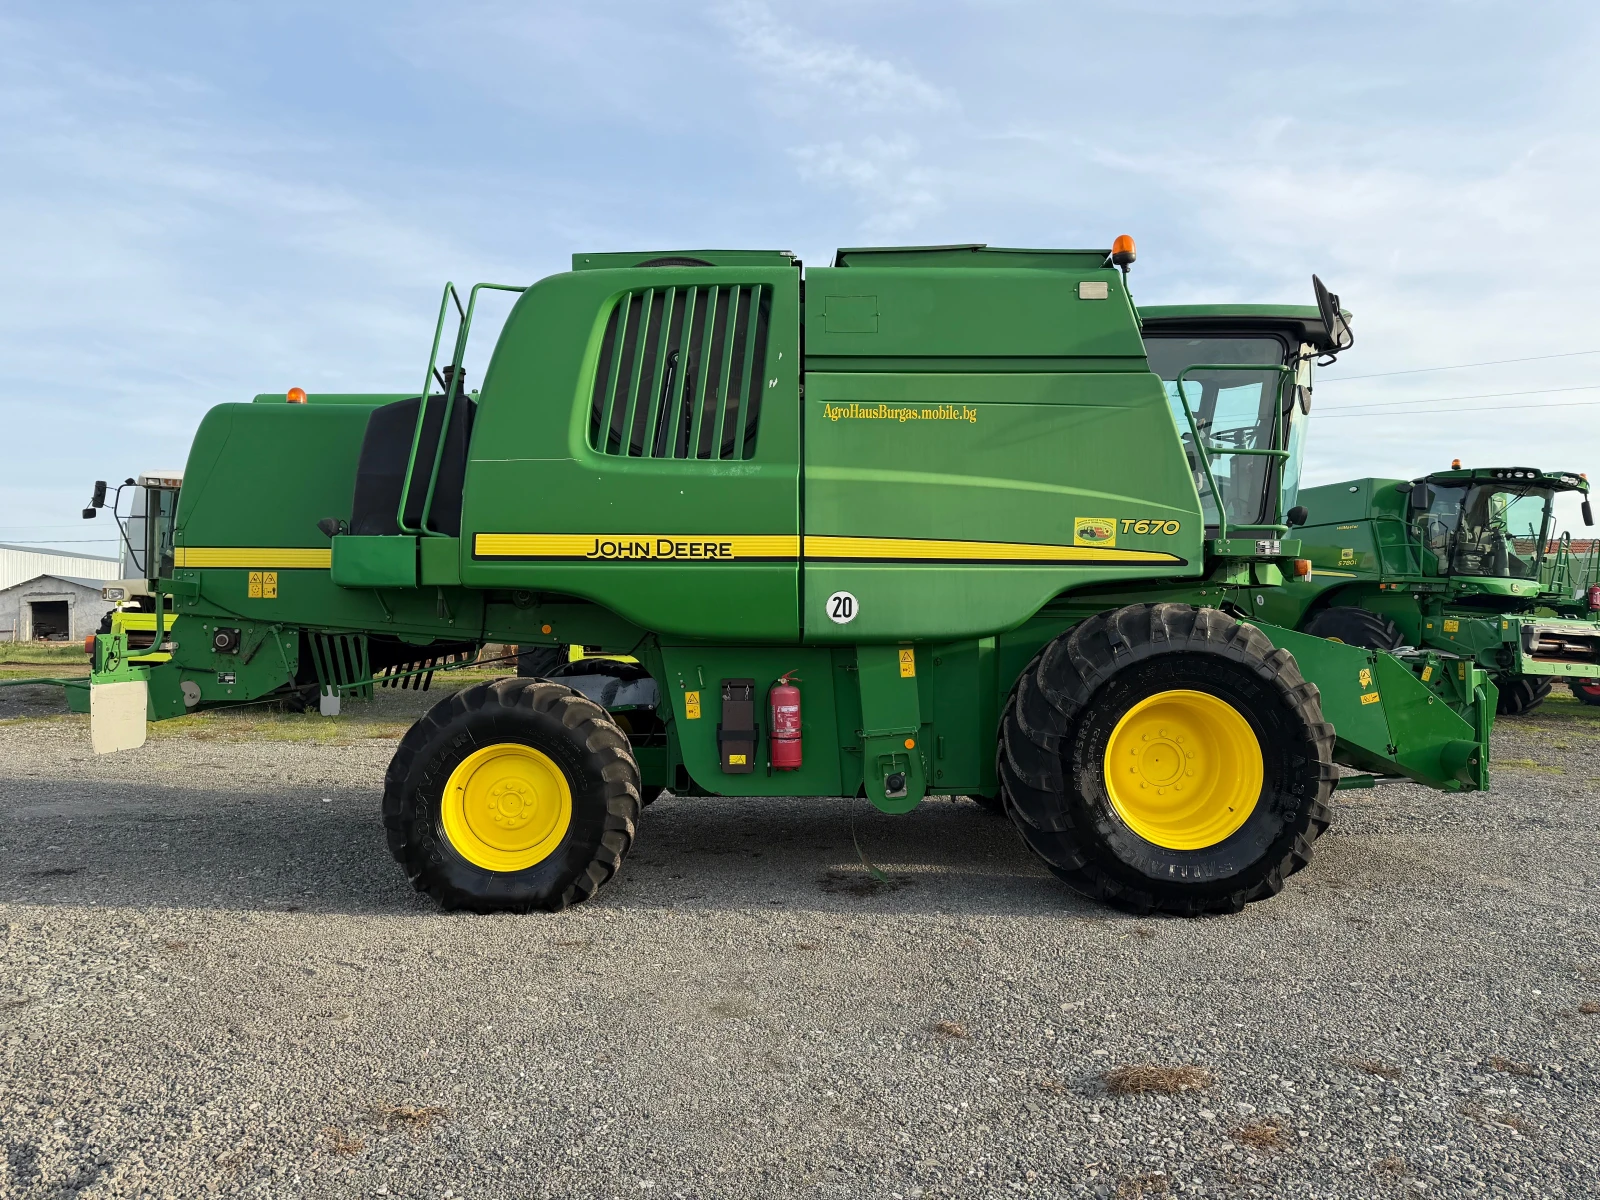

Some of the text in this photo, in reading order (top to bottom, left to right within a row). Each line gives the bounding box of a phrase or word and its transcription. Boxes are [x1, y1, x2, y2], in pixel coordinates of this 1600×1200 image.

[823, 403, 977, 423] AgroHausBurgas.mobile.bg
[1120, 519, 1181, 535] T670
[586, 538, 733, 558] JOHN DEERE
[832, 596, 853, 618] 20
[415, 732, 470, 865] GOODYEAR
